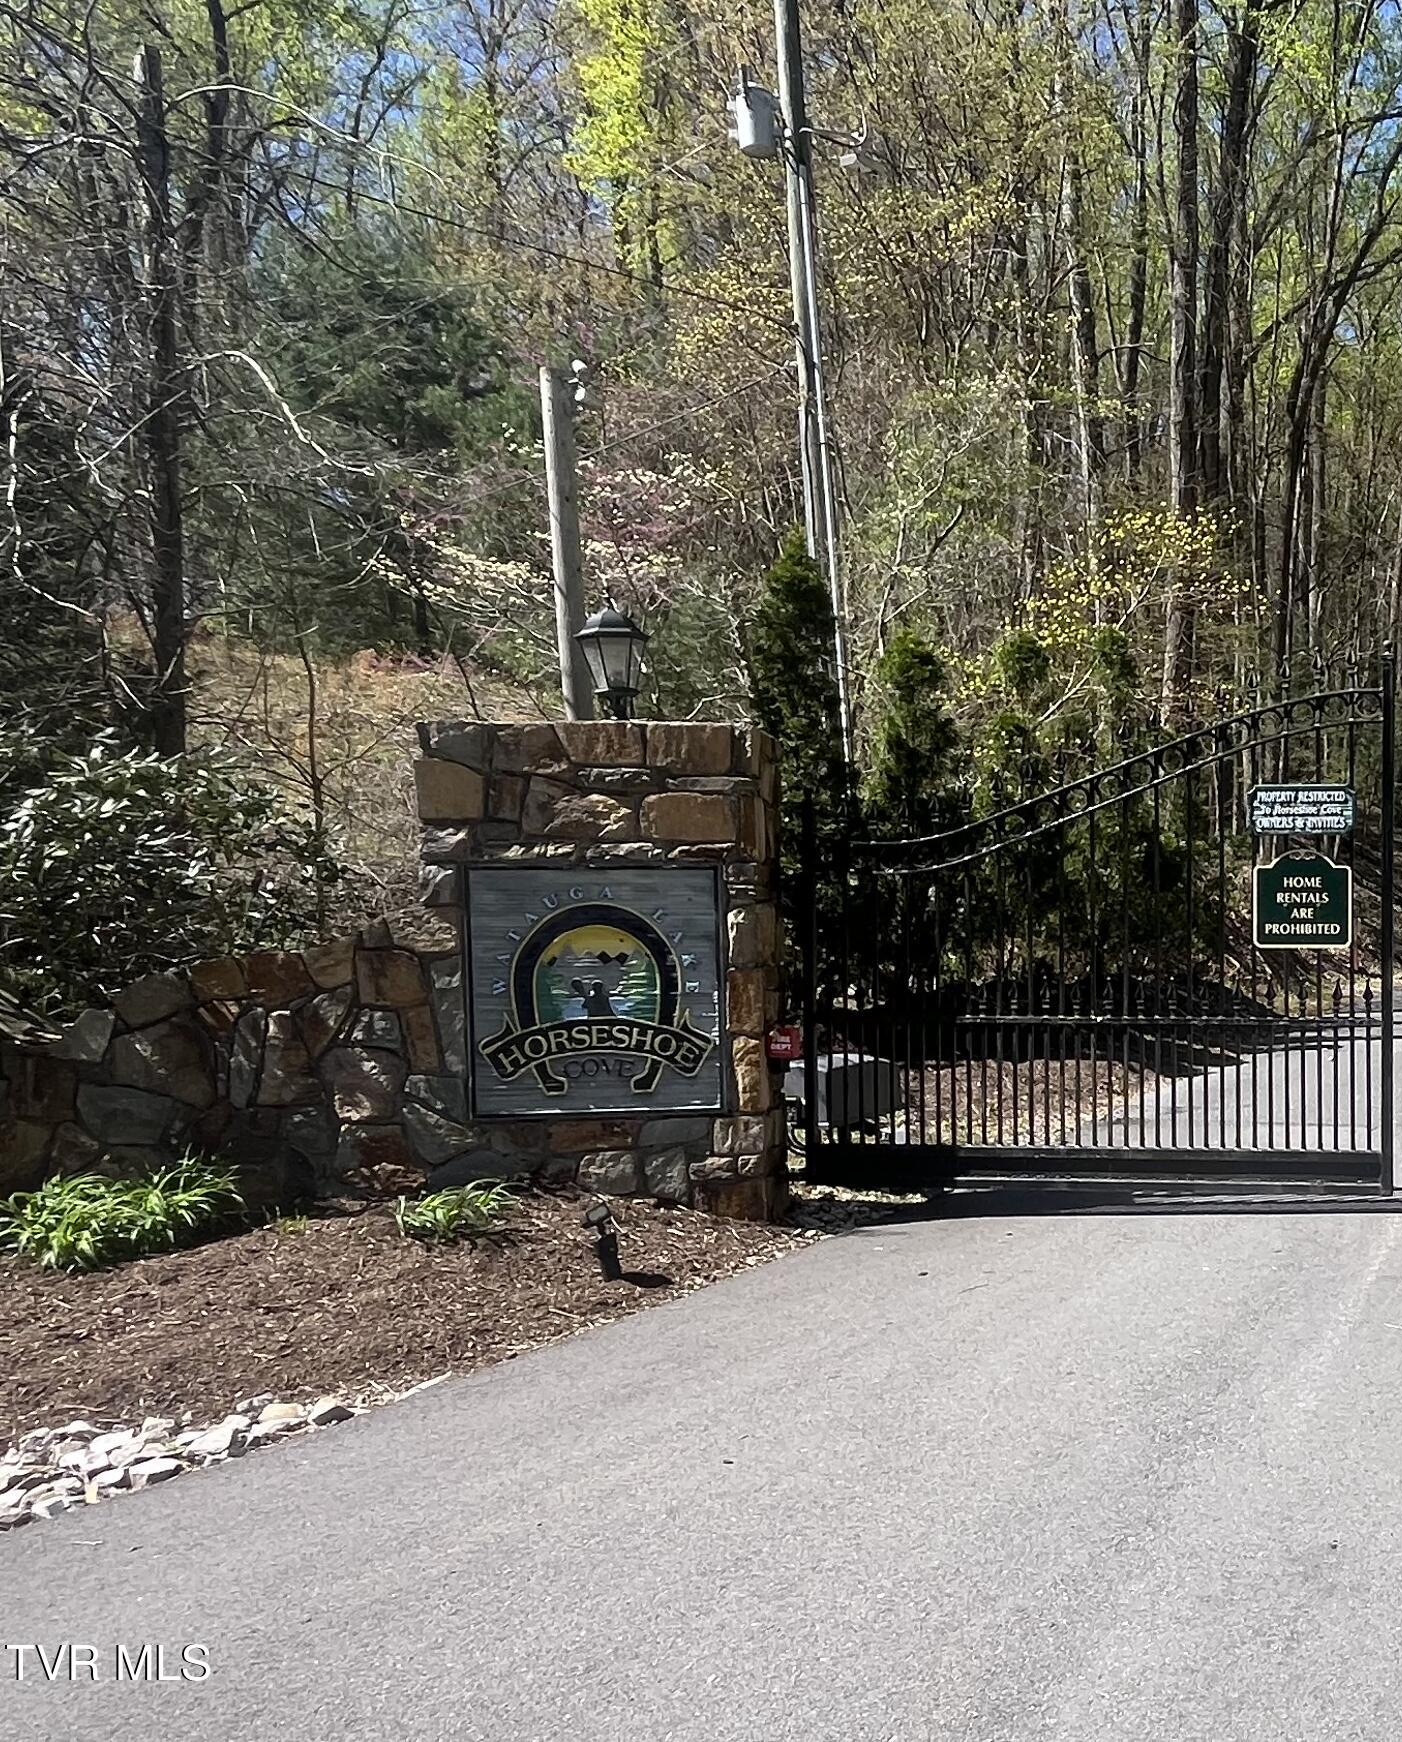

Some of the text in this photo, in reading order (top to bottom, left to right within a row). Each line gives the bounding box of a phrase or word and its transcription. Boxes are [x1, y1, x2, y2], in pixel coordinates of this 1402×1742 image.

[1256, 790, 1346, 802] PROPERTY RESTRICTED
[1319, 803, 1342, 815] Cove
[1256, 816, 1294, 828] OWNERS
[1283, 876, 1322, 889] HOME
[1276, 892, 1329, 904] RENTALS
[1290, 907, 1314, 919] ARE
[1264, 923, 1341, 935] PROHIBITED
[491, 886, 700, 996] WATAUGA LAKE
[498, 1025, 700, 1074] HORSESHOE
[562, 1057, 638, 1079] COVE
